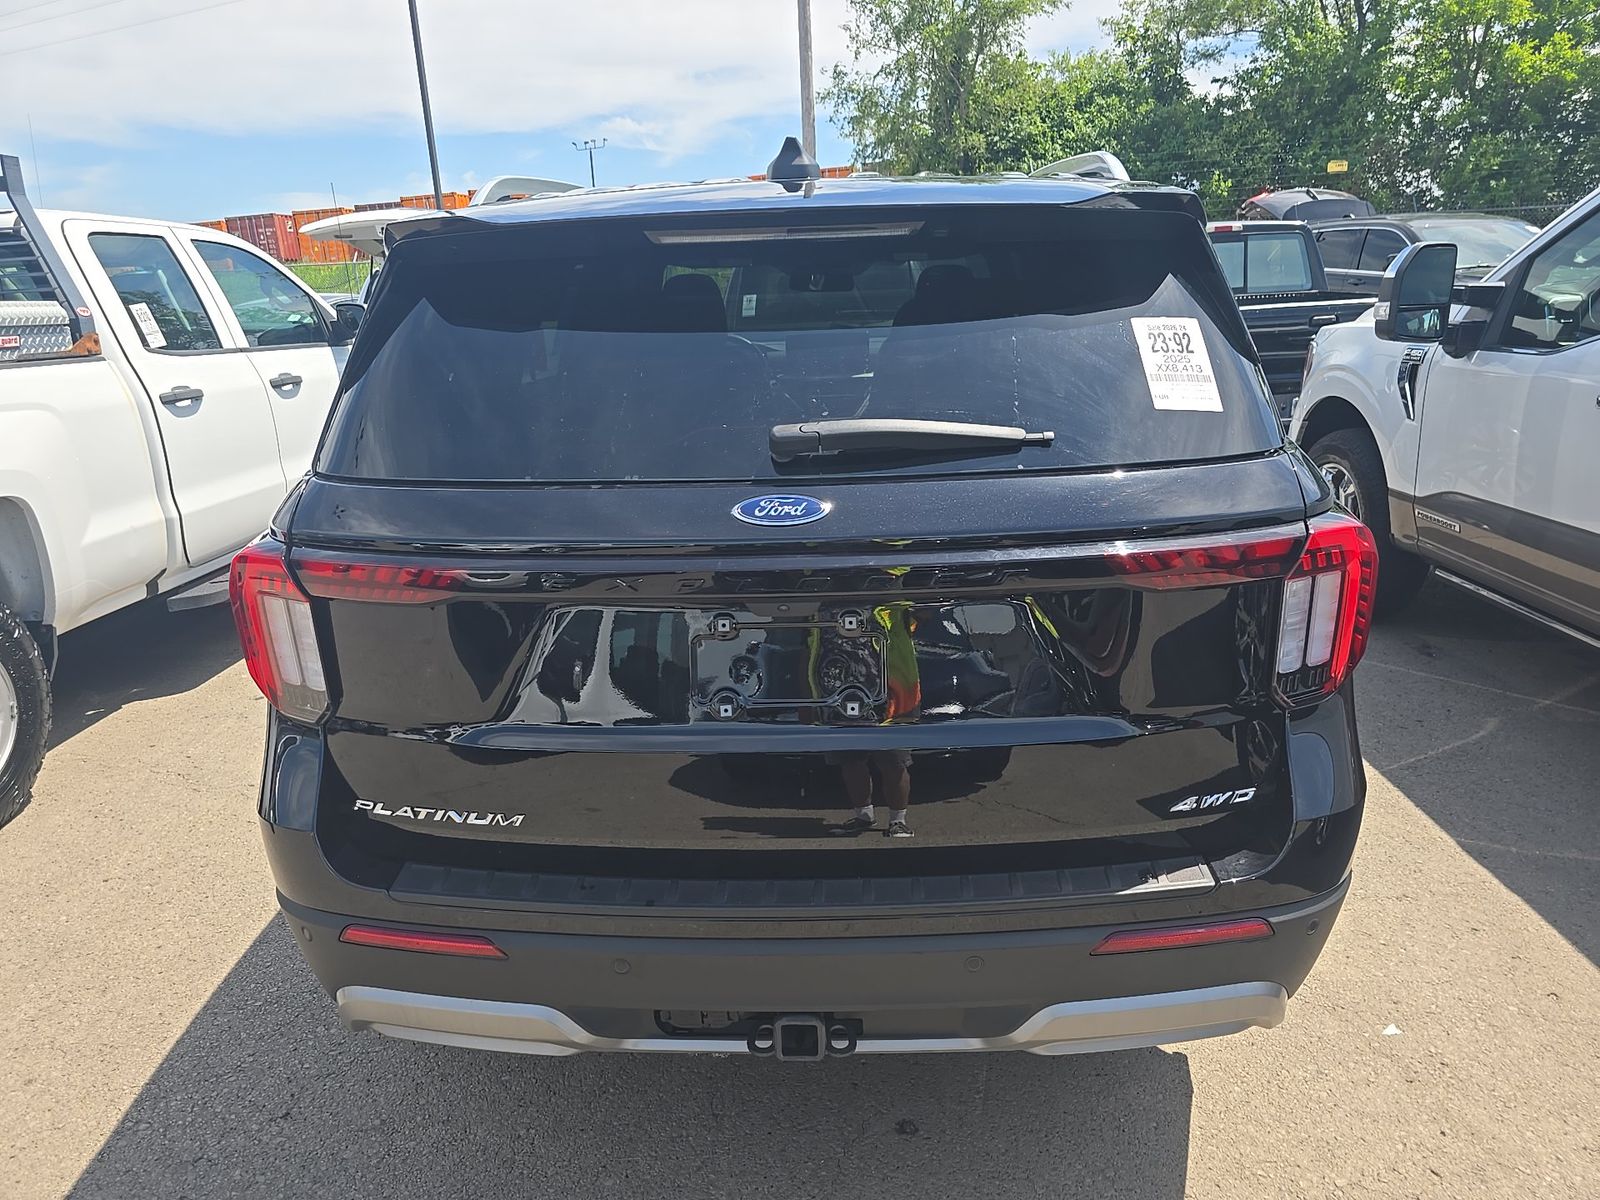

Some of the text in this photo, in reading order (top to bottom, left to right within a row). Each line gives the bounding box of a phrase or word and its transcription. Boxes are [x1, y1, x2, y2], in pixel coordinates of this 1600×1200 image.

[1148, 332, 1195, 354] 23:92
[1162, 354, 1191, 364] 2025
[754, 498, 808, 517] Ford
[1169, 787, 1257, 813] 4WD
[354, 799, 526, 827] PLATINUM
